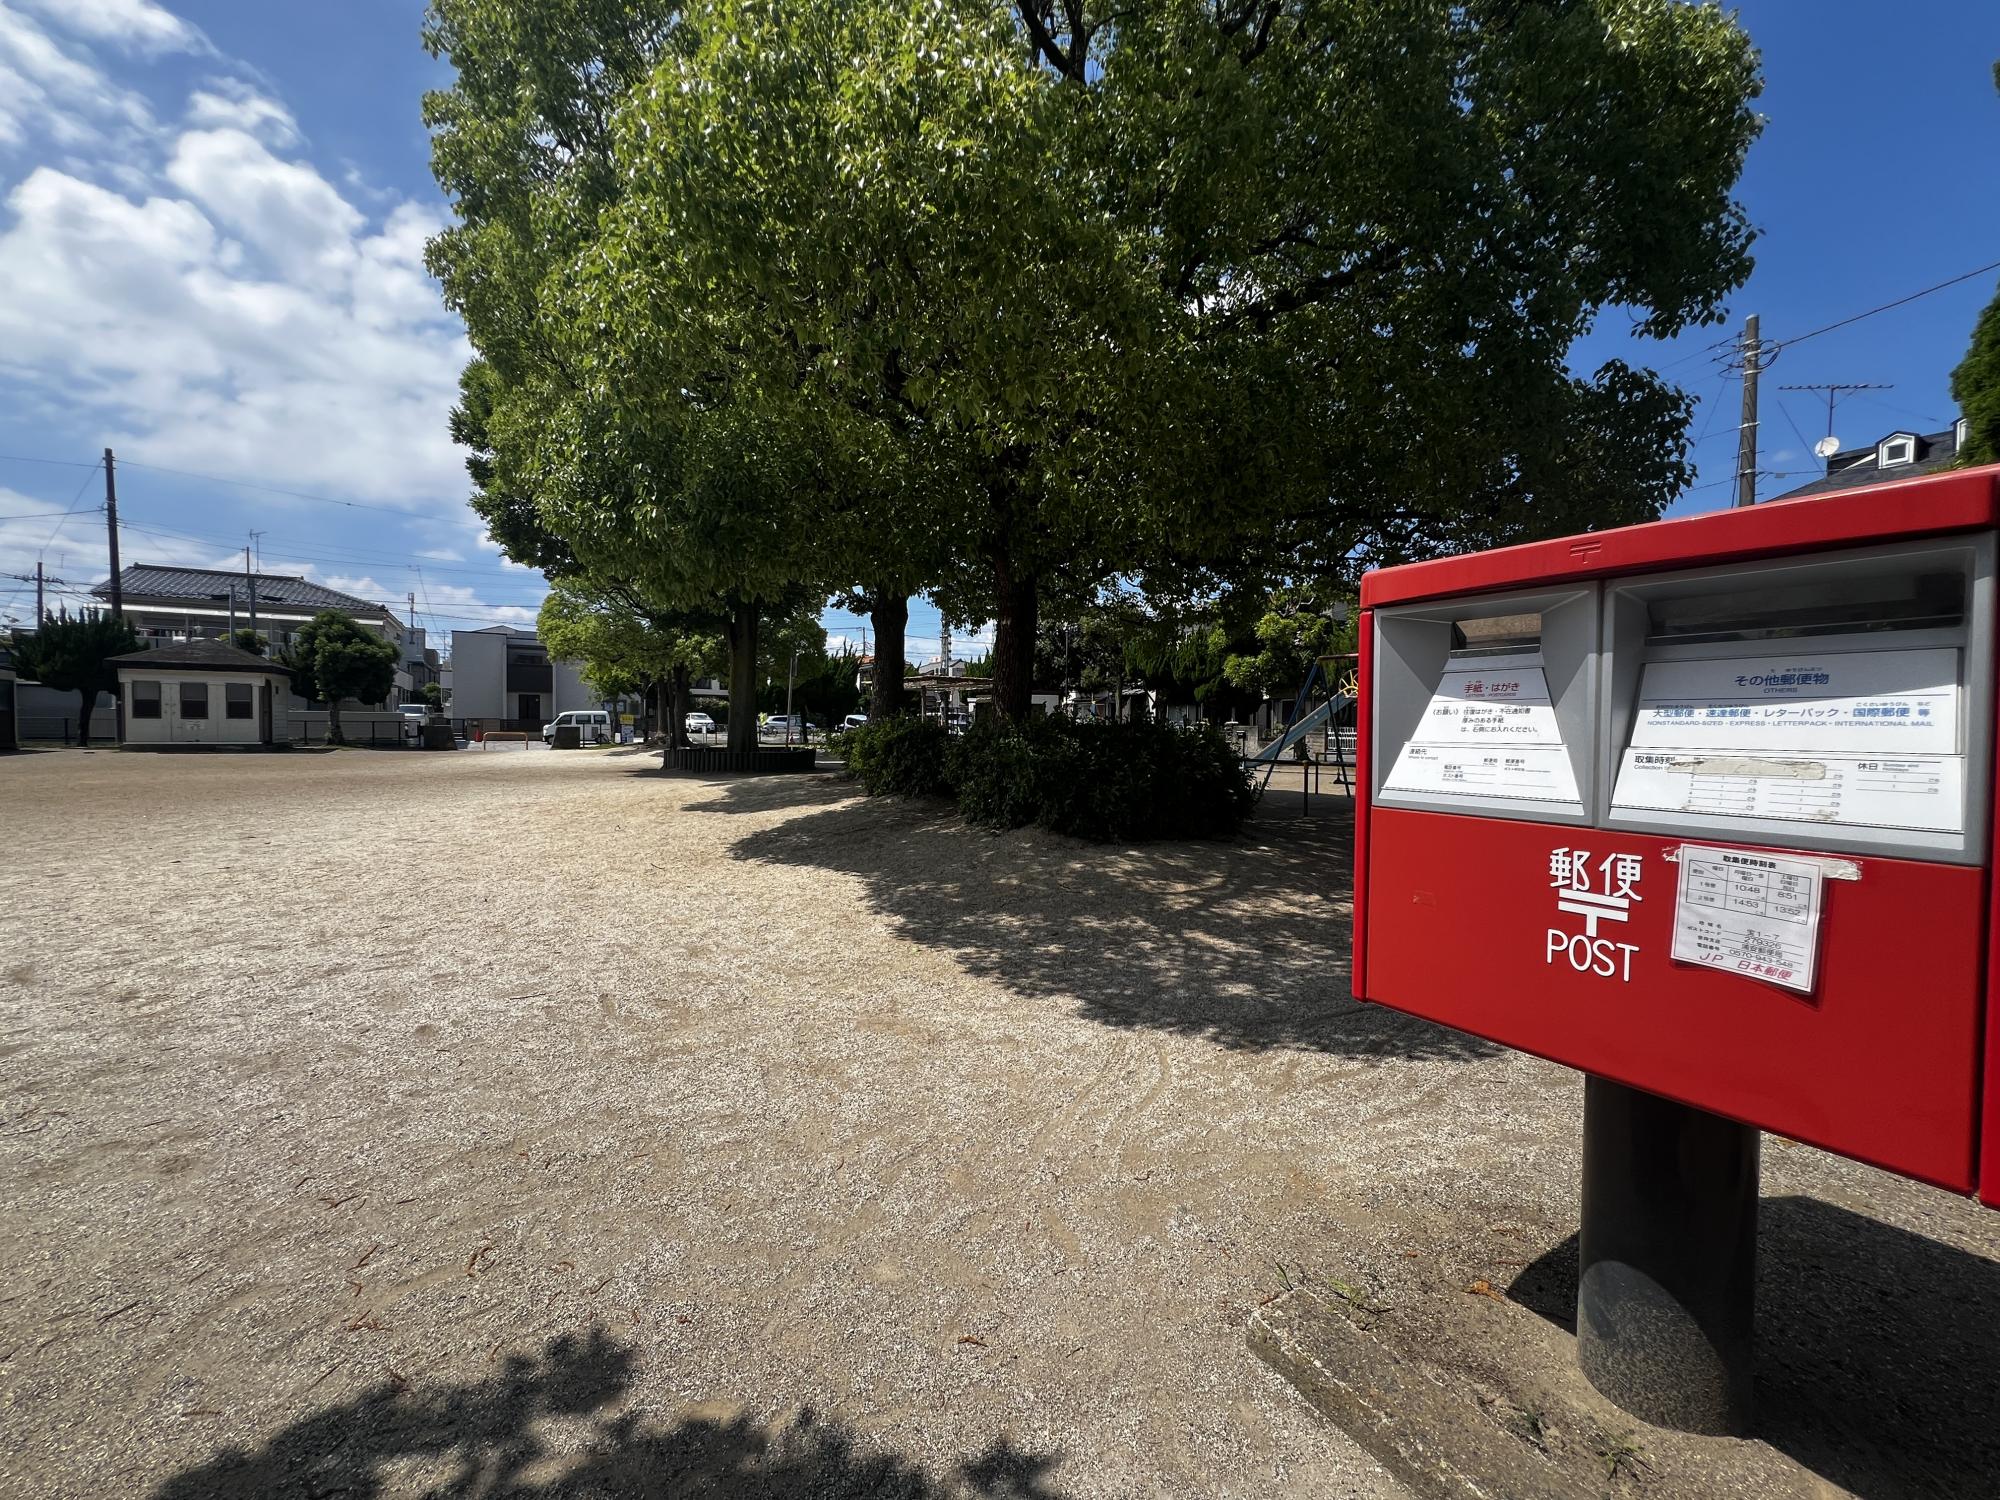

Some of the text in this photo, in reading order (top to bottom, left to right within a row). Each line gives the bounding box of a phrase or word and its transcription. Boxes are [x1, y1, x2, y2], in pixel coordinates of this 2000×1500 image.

[1463, 682, 1520, 694] 手紙・はがき
[1734, 672, 1830, 687] その他郵便物
[1857, 762, 1879, 770] 休日
[1549, 847, 1643, 901] 郵便
[1546, 928, 1640, 982] POST
[1737, 959, 1793, 981] 日本郵便
